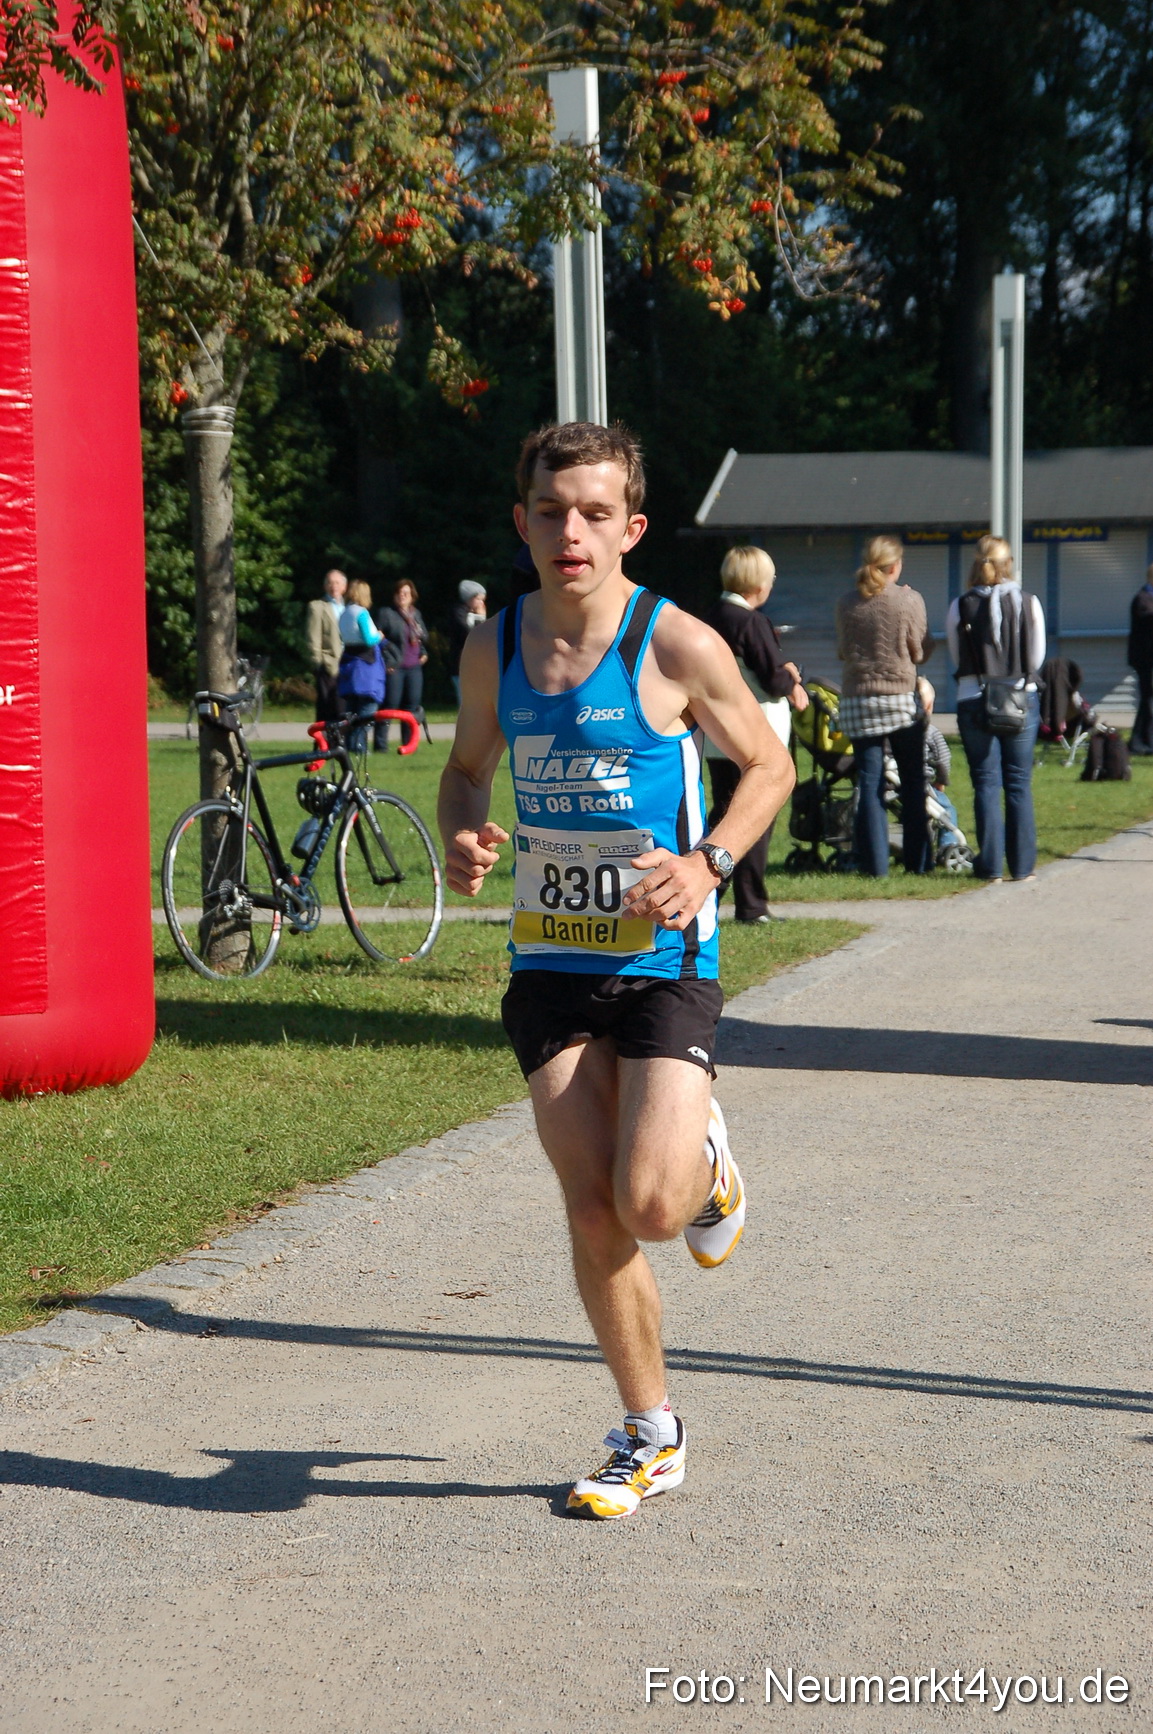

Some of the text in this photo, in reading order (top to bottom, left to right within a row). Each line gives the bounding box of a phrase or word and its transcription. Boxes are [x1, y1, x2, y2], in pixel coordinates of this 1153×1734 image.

[550, 747, 634, 757] Versicherungsbüro
[527, 755, 629, 780] NAGEL
[536, 783, 583, 793] Nagel-Team
[518, 791, 634, 814] TSG 08 Roth
[530, 837, 583, 854] PFLEIDERER
[539, 862, 621, 913] 830
[542, 914, 618, 943] Daniel
